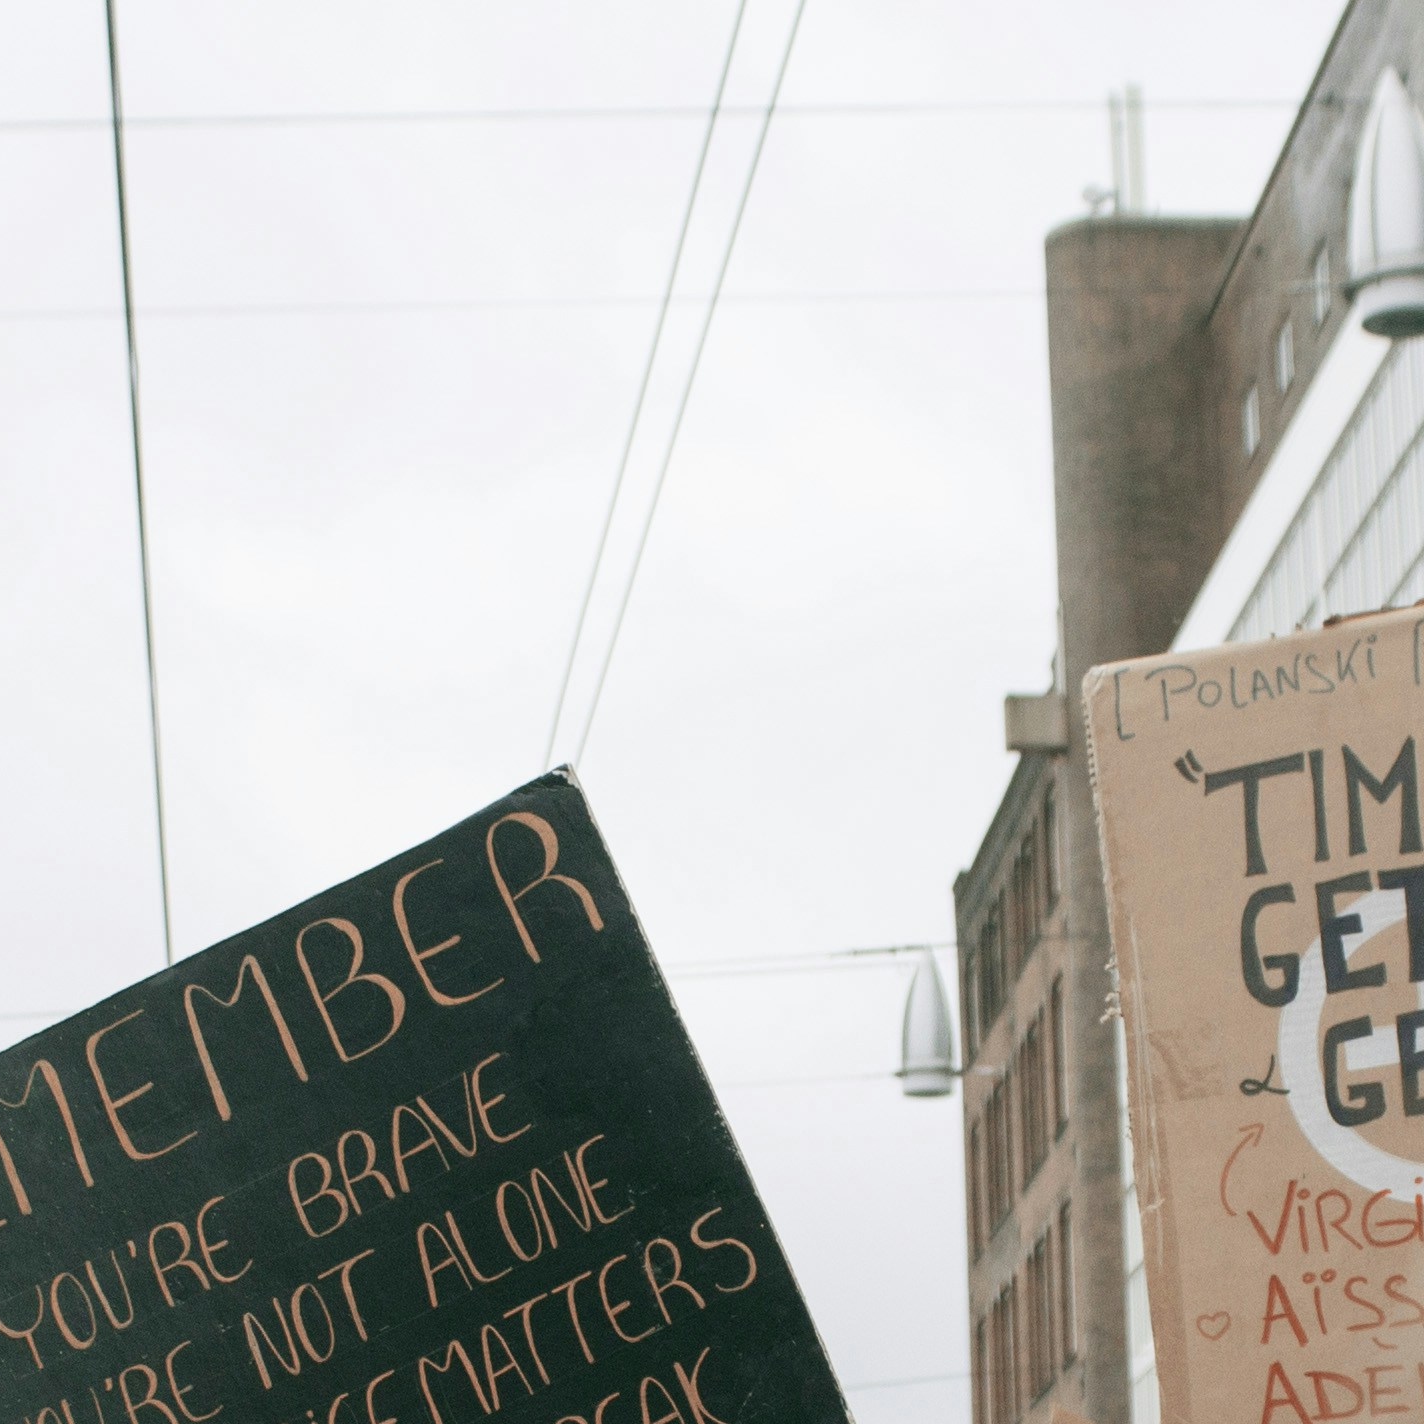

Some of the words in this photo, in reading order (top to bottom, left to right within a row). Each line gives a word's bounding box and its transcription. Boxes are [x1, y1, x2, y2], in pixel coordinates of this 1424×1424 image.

[287, 1052, 533, 1238] BRAVE
[243, 1248, 375, 1390] NOT
[416, 1134, 635, 1309] ALONE
